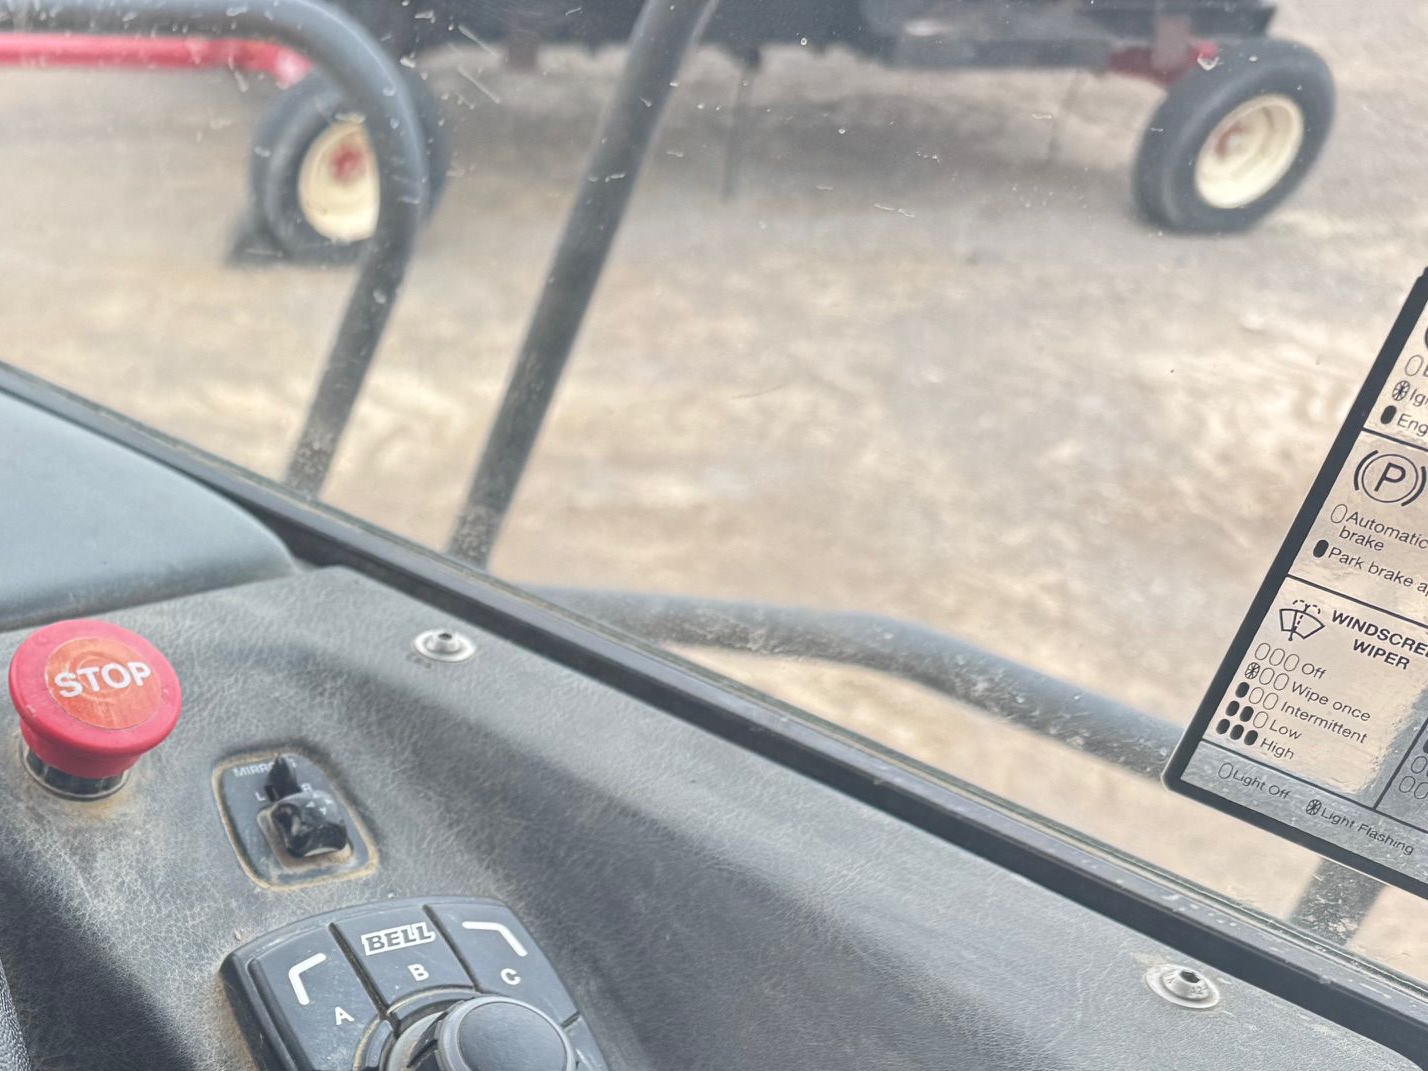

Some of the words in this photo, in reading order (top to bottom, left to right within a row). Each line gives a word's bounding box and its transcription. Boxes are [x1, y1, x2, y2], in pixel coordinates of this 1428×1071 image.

[1373, 461, 1407, 493] P
[1338, 525, 1385, 551] brake
[1345, 511, 1428, 550] Automatic
[1328, 546, 1365, 570] Park
[1367, 561, 1414, 588] brake
[1352, 638, 1411, 670] WIPER
[54, 660, 153, 699] STOP
[1301, 661, 1327, 680] Off
[1291, 680, 1330, 707] Wipe
[1332, 700, 1372, 723] once
[1269, 720, 1303, 741] Low
[1279, 701, 1369, 745] Intermittent
[1260, 737, 1295, 761] High
[254, 791, 266, 801] L
[1232, 768, 1267, 793] Light
[1268, 784, 1292, 801] Off
[1320, 806, 1356, 832] Light
[1357, 823, 1415, 856] Flashing
[365, 923, 433, 953] BELL
[408, 963, 430, 981] B
[500, 967, 522, 985] C
[334, 1006, 355, 1026] A
